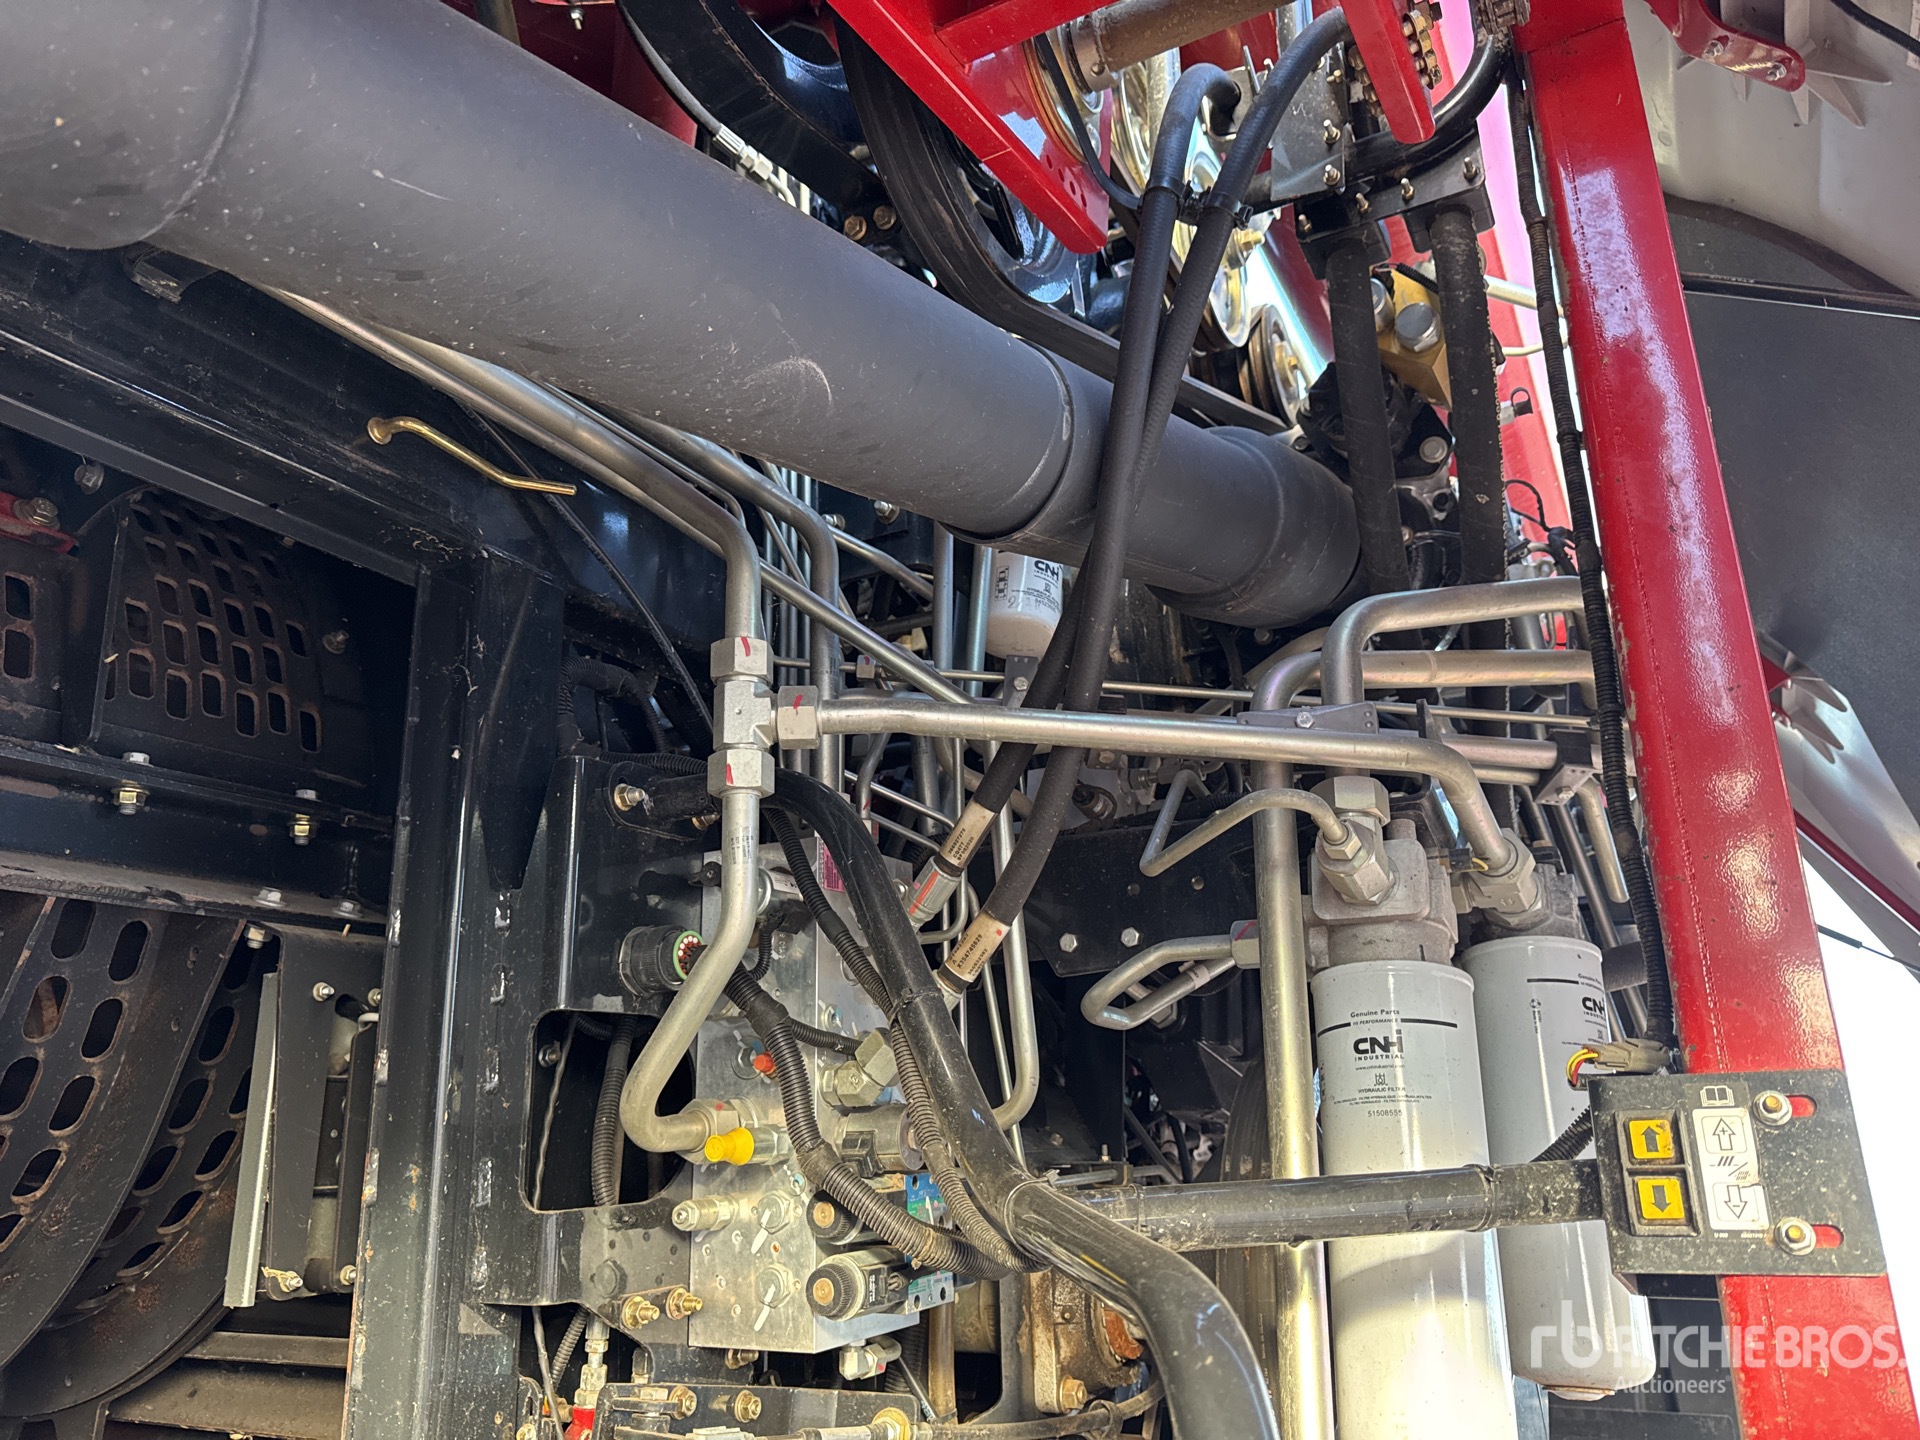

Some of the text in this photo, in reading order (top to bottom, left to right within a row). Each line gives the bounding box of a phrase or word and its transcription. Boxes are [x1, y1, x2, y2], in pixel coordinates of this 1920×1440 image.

[1034, 560, 1060, 581] CNH
[1350, 1010, 1378, 1018] Genuine
[1353, 1029, 1404, 1054] CNH
[1354, 1054, 1405, 1062] INDUSTRIAL
